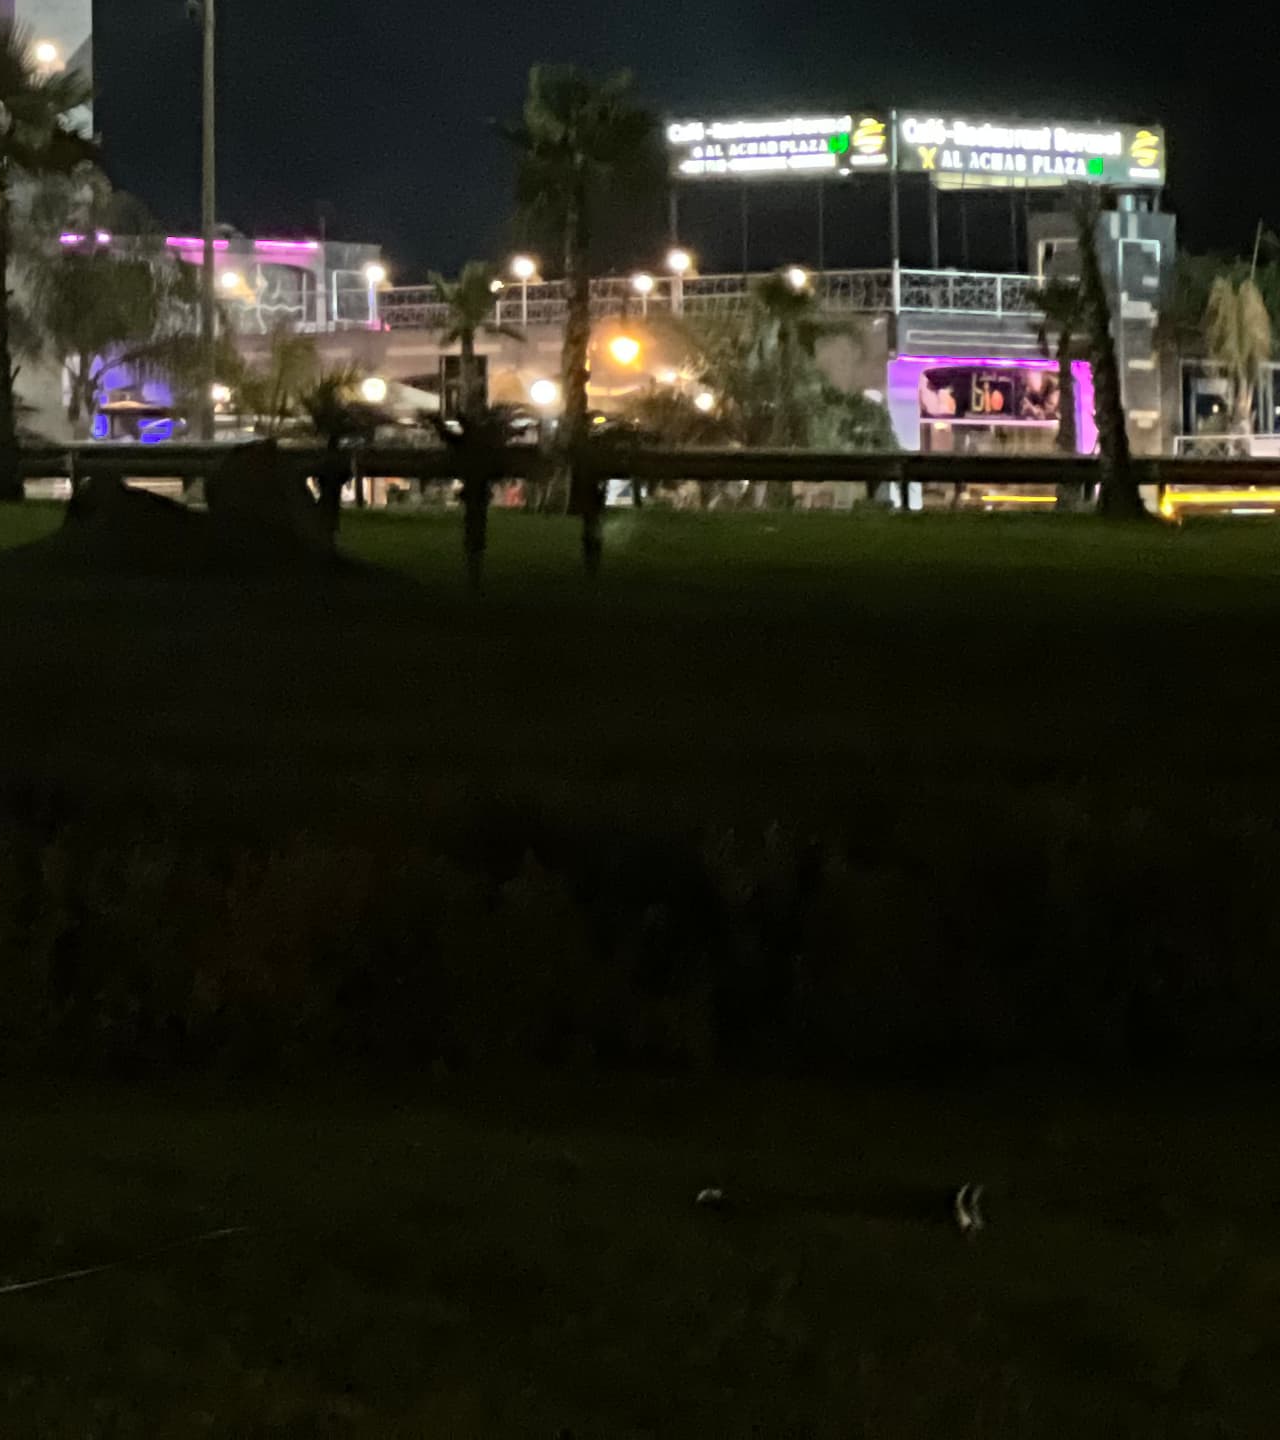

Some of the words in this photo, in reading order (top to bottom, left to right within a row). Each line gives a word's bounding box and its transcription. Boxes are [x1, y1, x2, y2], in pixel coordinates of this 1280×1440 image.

[705, 144, 723, 157] AL
[779, 139, 828, 154] PLAZA
[942, 150, 962, 169] AL
[1032, 155, 1087, 176] PLAZA
